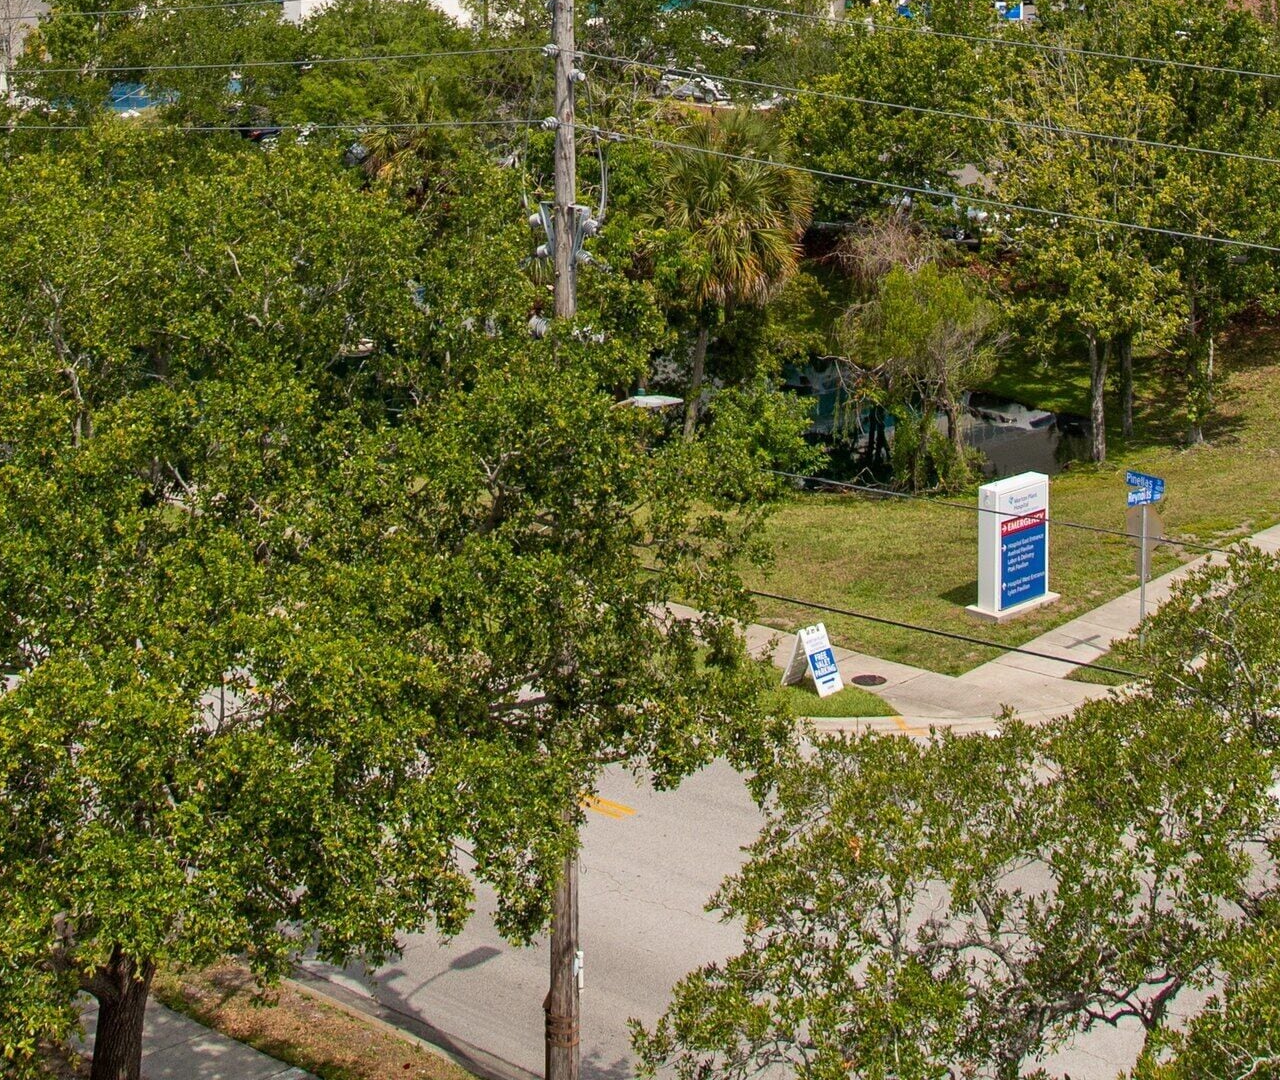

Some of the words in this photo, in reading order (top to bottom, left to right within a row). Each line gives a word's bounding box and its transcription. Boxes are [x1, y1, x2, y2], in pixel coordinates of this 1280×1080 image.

[1126, 472, 1153, 489] Pinellas
[1008, 512, 1045, 531] EMERGENCY
[814, 650, 827, 661] FREE
[815, 664, 837, 678] PARKING
